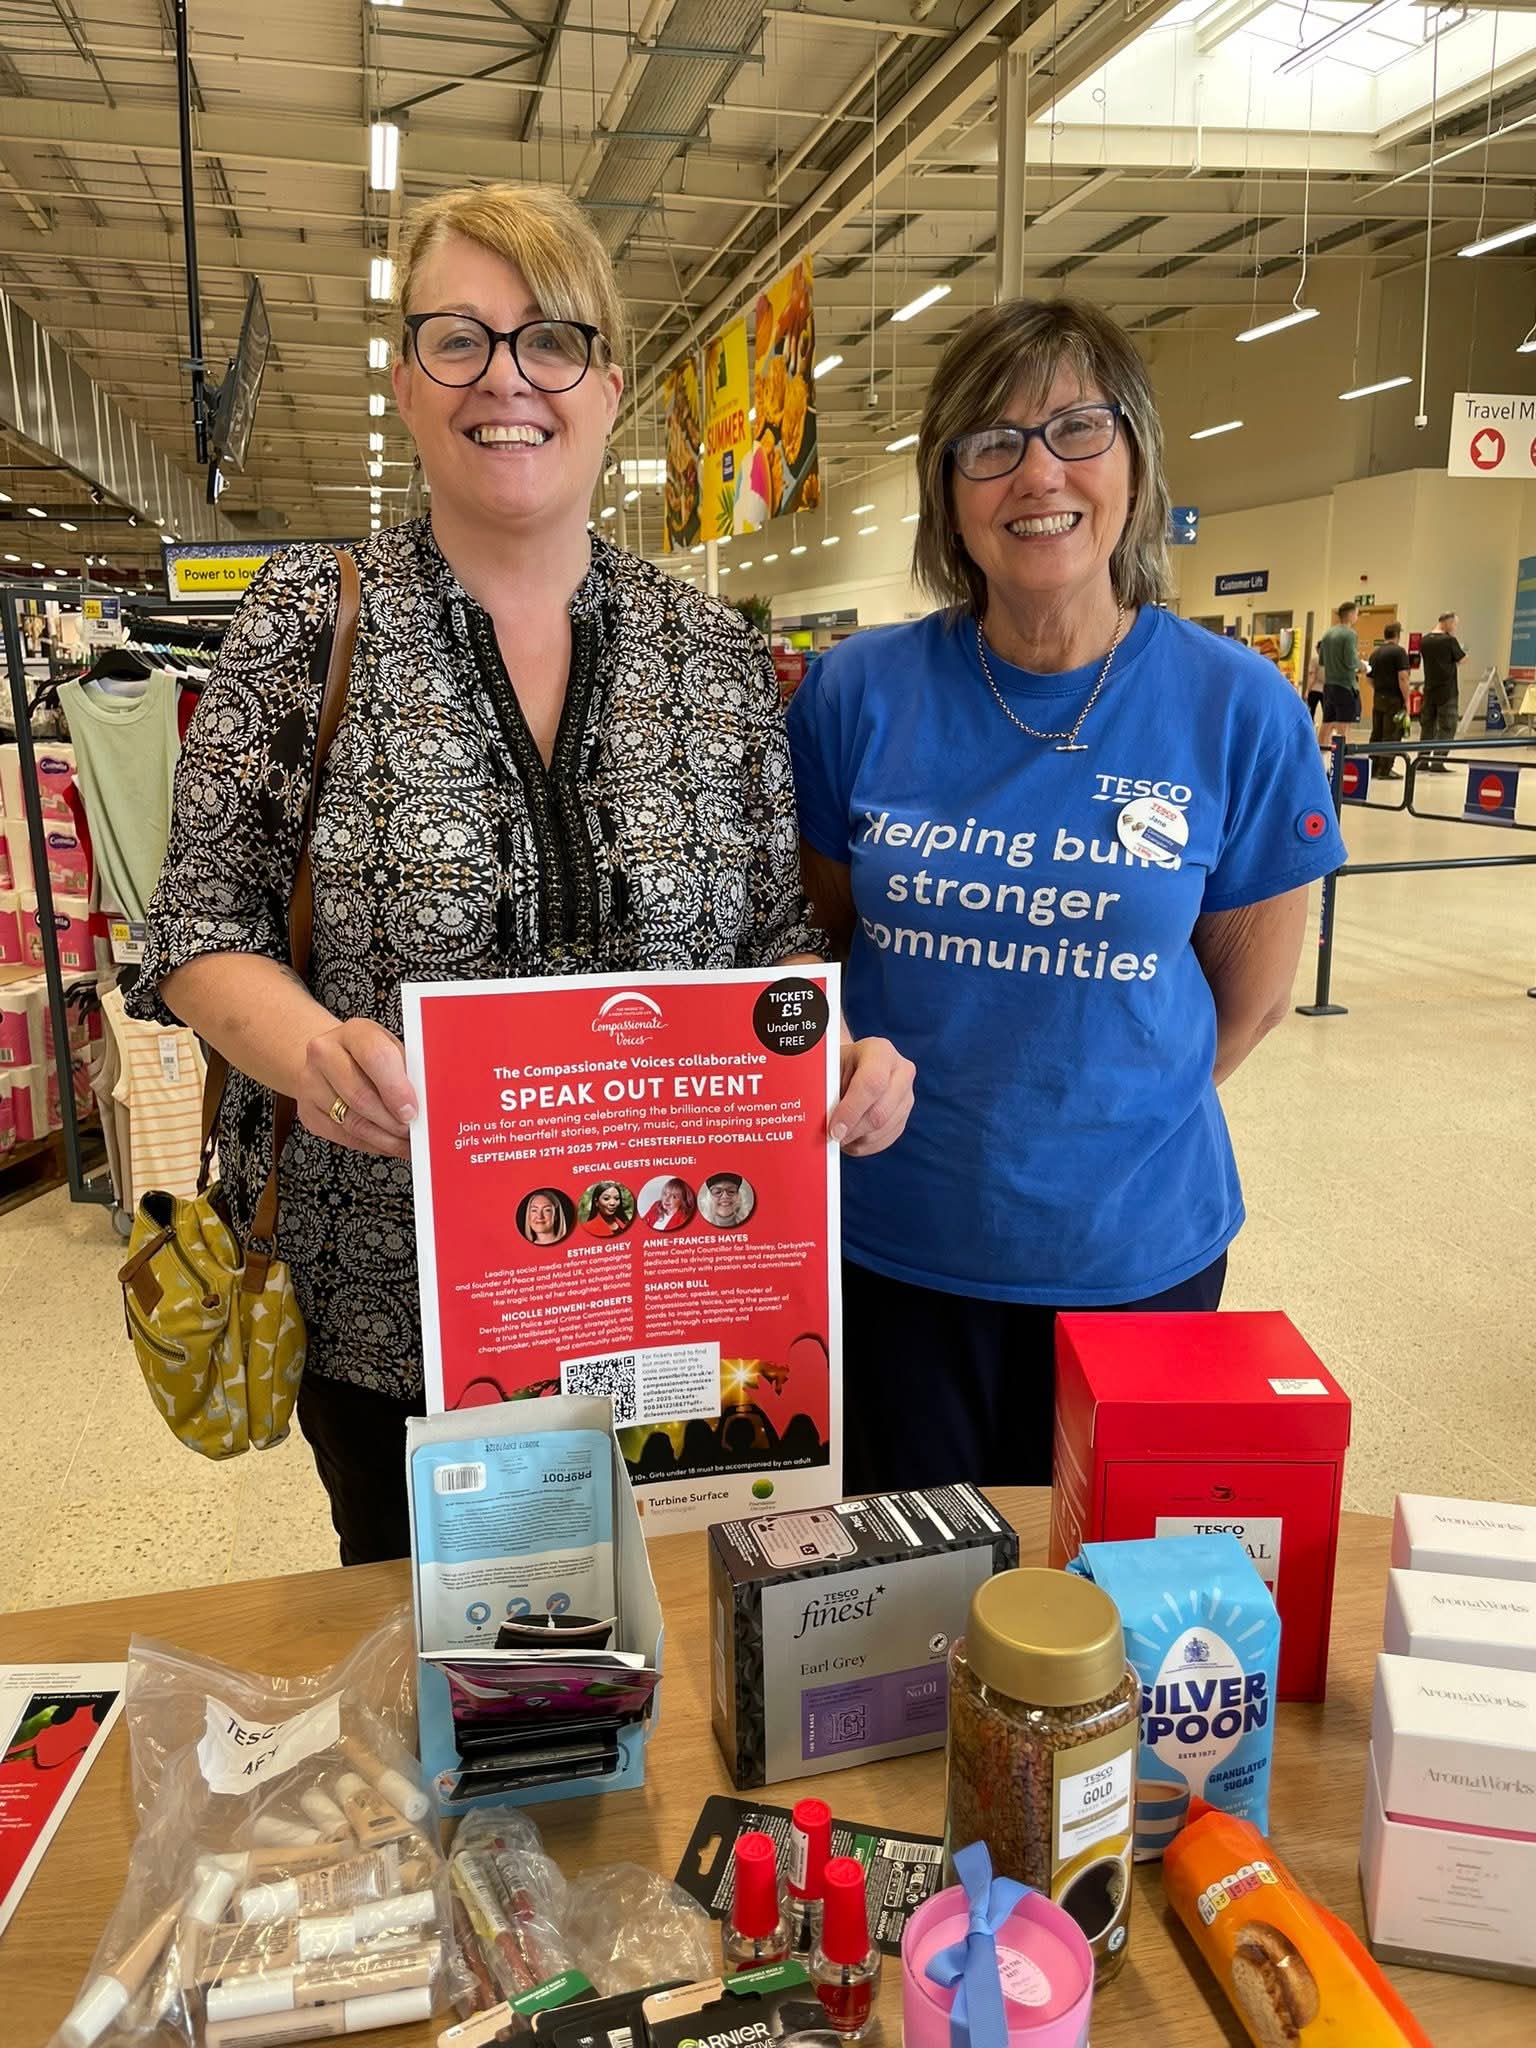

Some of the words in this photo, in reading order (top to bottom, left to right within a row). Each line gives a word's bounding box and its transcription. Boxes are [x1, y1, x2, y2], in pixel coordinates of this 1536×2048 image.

[1465, 399, 1515, 419] Travel
[707, 409, 746, 457] SUMMER
[184, 569, 220, 580] Power
[223, 569, 236, 579] to
[1220, 579, 1250, 591] Customer
[1250, 576, 1263, 588] Lift
[1095, 774, 1192, 804] TESCO
[1149, 815, 1167, 828] Jane
[863, 811, 1037, 868] Helping
[885, 869, 1121, 927] stronger
[861, 916, 1159, 983] communities
[768, 990, 814, 1003] TICKETS
[781, 1003, 802, 1017] £5
[591, 1017, 668, 1038] Compassionate
[767, 1021, 799, 1033] Under
[801, 1020, 817, 1031] 18s
[615, 1031, 653, 1046] Voices
[779, 1035, 806, 1047] FREE
[493, 1067, 520, 1080] The
[524, 1060, 627, 1079] Compassionate
[631, 1057, 675, 1068] Voices
[679, 1053, 767, 1067] collaborative
[500, 1082, 595, 1111] SPEAK
[603, 1078, 665, 1102] OUT
[674, 1074, 763, 1098] EVENT
[458, 1121, 481, 1135] Join
[484, 1122, 497, 1131] us
[499, 1118, 516, 1129] for
[518, 1119, 534, 1128] an
[537, 1113, 581, 1126] evening
[584, 1107, 646, 1121] celebrating
[650, 1106, 667, 1116] the
[670, 1103, 721, 1115] brilliance
[724, 1103, 735, 1113] of
[736, 1103, 777, 1112] women
[780, 1098, 801, 1109] and
[454, 1135, 479, 1150] girls
[482, 1133, 507, 1145] with
[510, 1128, 558, 1143] heartfelt
[561, 1126, 600, 1138] stories,
[603, 1123, 640, 1135] poetry,
[644, 1119, 678, 1130] music,
[681, 1117, 702, 1128] and
[706, 1115, 753, 1128] inspiring
[755, 1112, 806, 1126] speakers!
[470, 1149, 536, 1164] SEPTEMBER
[539, 1146, 565, 1157] 12TH
[567, 1144, 592, 1155] 2025
[596, 1140, 618, 1150] 7PM
[628, 1134, 706, 1148] CHESTERFIELD
[708, 1132, 763, 1143] FOOTBALL
[766, 1131, 793, 1142] CLUB
[572, 1163, 612, 1175] SPECIAL
[613, 1159, 650, 1170] GUESTS
[653, 1156, 697, 1167] INCLUDE:
[567, 1245, 603, 1258] ESTHER
[605, 1241, 632, 1252] GHEY
[643, 1235, 716, 1248] ANNE-FRANCES
[718, 1233, 748, 1243] HAYES
[644, 1281, 684, 1292] SHARON
[686, 1279, 709, 1289] BULL
[501, 1307, 543, 1322] NICOLLE
[544, 1295, 633, 1316] NDIWENI-ROBERTS
[635, 1474, 648, 1482] 10+.
[649, 1471, 665, 1480] Girls
[666, 1468, 687, 1477] under
[697, 1465, 713, 1473] must
[714, 1464, 724, 1472] be
[725, 1460, 772, 1471] accompanied
[773, 1460, 782, 1468] by
[648, 1494, 688, 1508] Turbine
[690, 1489, 729, 1503] Surface
[1194, 1525, 1245, 1538] TESCO
[1431, 1513, 1525, 1532] AromaWorks
[823, 1588, 859, 1601] TESCO
[1431, 1594, 1529, 1614] AromaWorks
[793, 1591, 878, 1639] finest
[801, 1659, 829, 1677] Earl
[832, 1654, 867, 1670] Grey
[1418, 1684, 1526, 1710] AromaWorks
[226, 1716, 285, 1747] TESC
[1084, 1766, 1113, 1785] TESCO
[1208, 1756, 1268, 1784] GRANULATED
[1223, 1775, 1255, 1792] SUGAR
[1423, 1768, 1535, 1794] AromaWorks
[1083, 1781, 1113, 1805] GOLD
